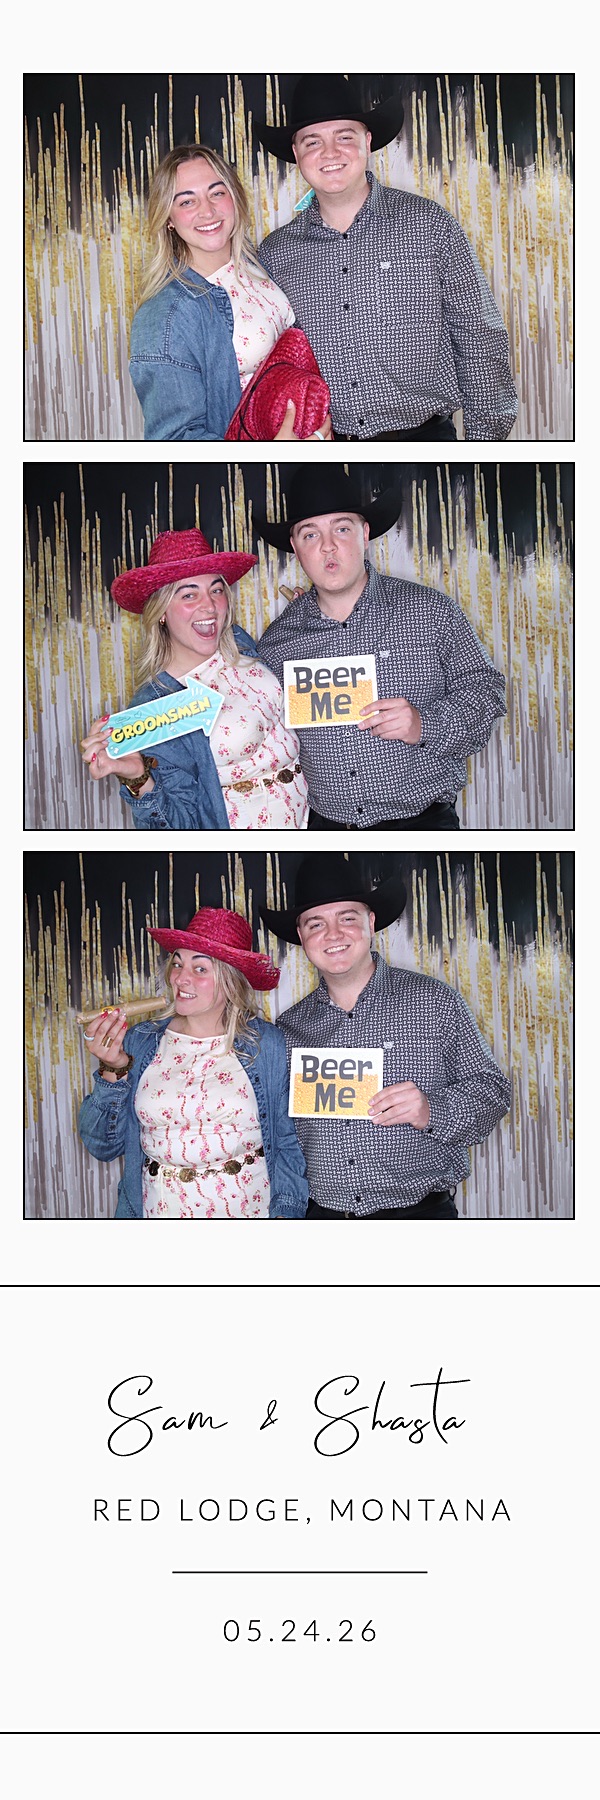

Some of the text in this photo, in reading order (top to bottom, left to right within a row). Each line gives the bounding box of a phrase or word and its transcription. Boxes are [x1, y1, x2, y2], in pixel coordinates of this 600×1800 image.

[293, 666, 366, 694] Beer
[111, 696, 212, 743] GROOMSMEN
[310, 691, 352, 722] Me
[301, 1054, 373, 1083] Beer
[314, 1082, 356, 1113] Me
